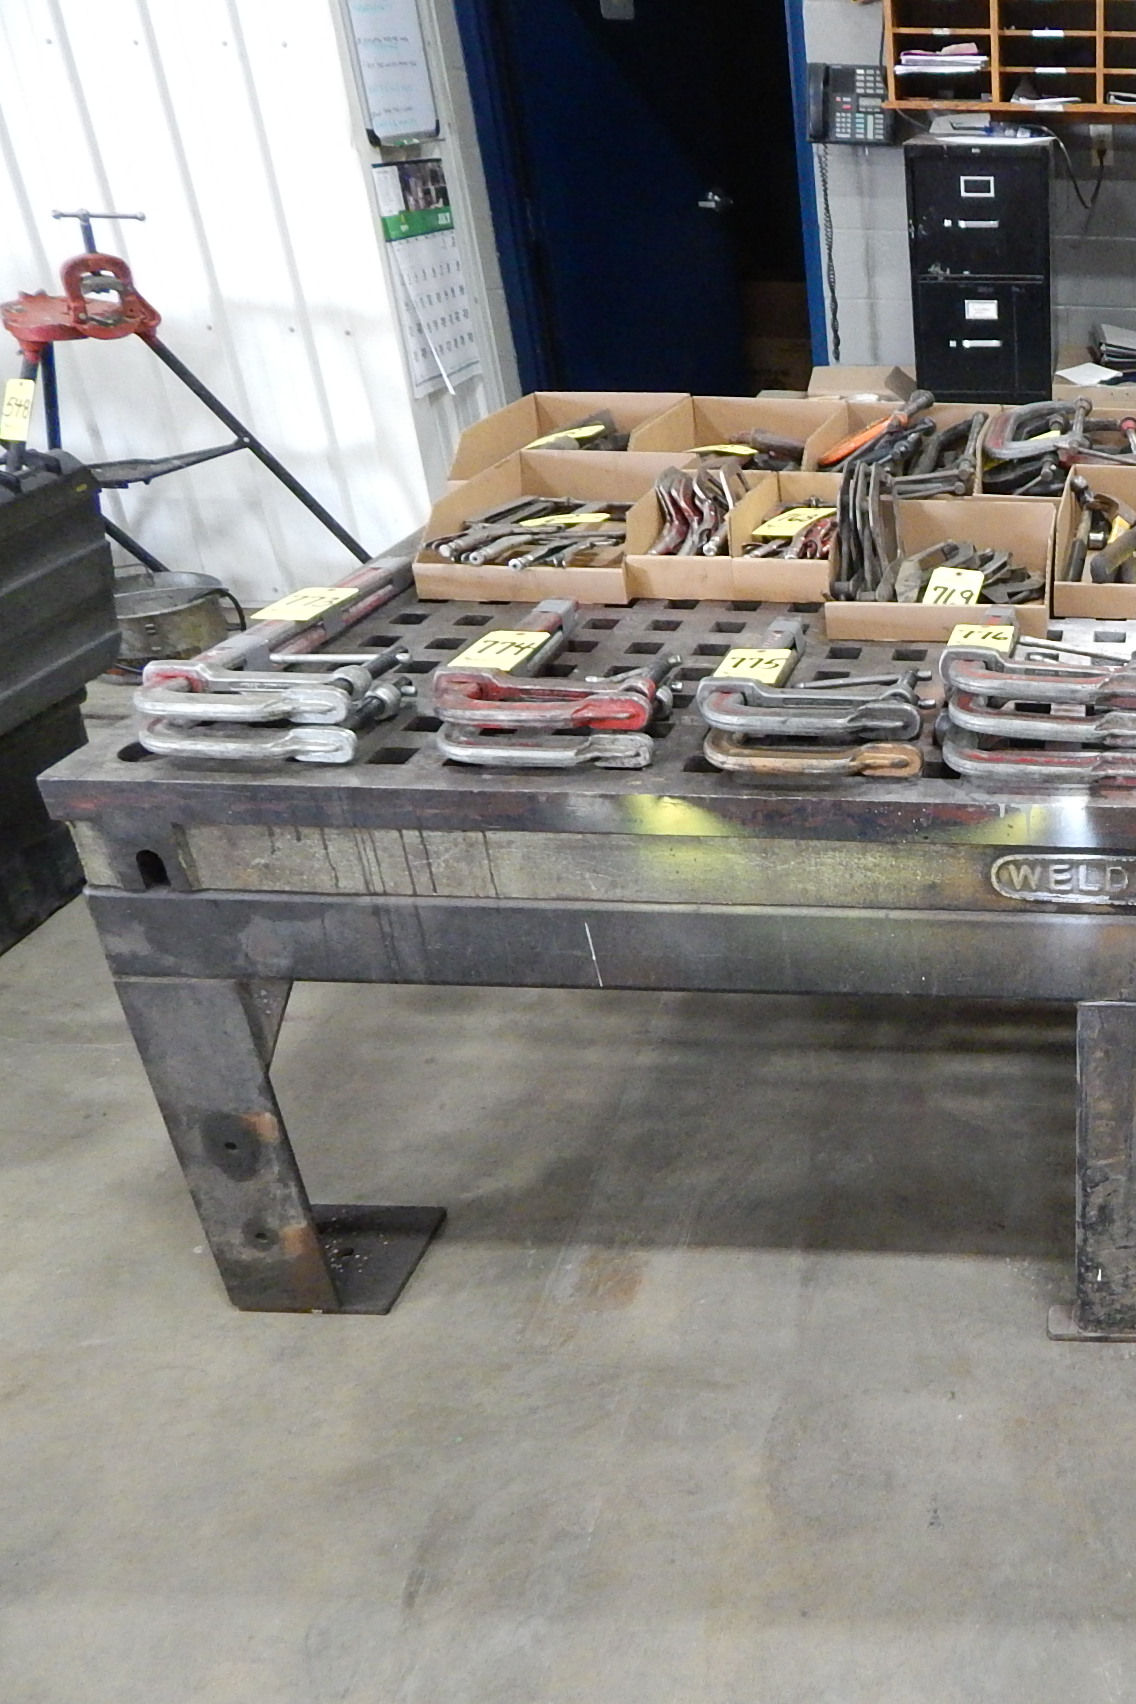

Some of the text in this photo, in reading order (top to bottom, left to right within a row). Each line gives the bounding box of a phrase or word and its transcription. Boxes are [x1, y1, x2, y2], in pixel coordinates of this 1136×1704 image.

[3, 396, 31, 419] 548
[958, 630, 1009, 641] 776
[477, 640, 537, 656] 774
[730, 657, 788, 669] 775
